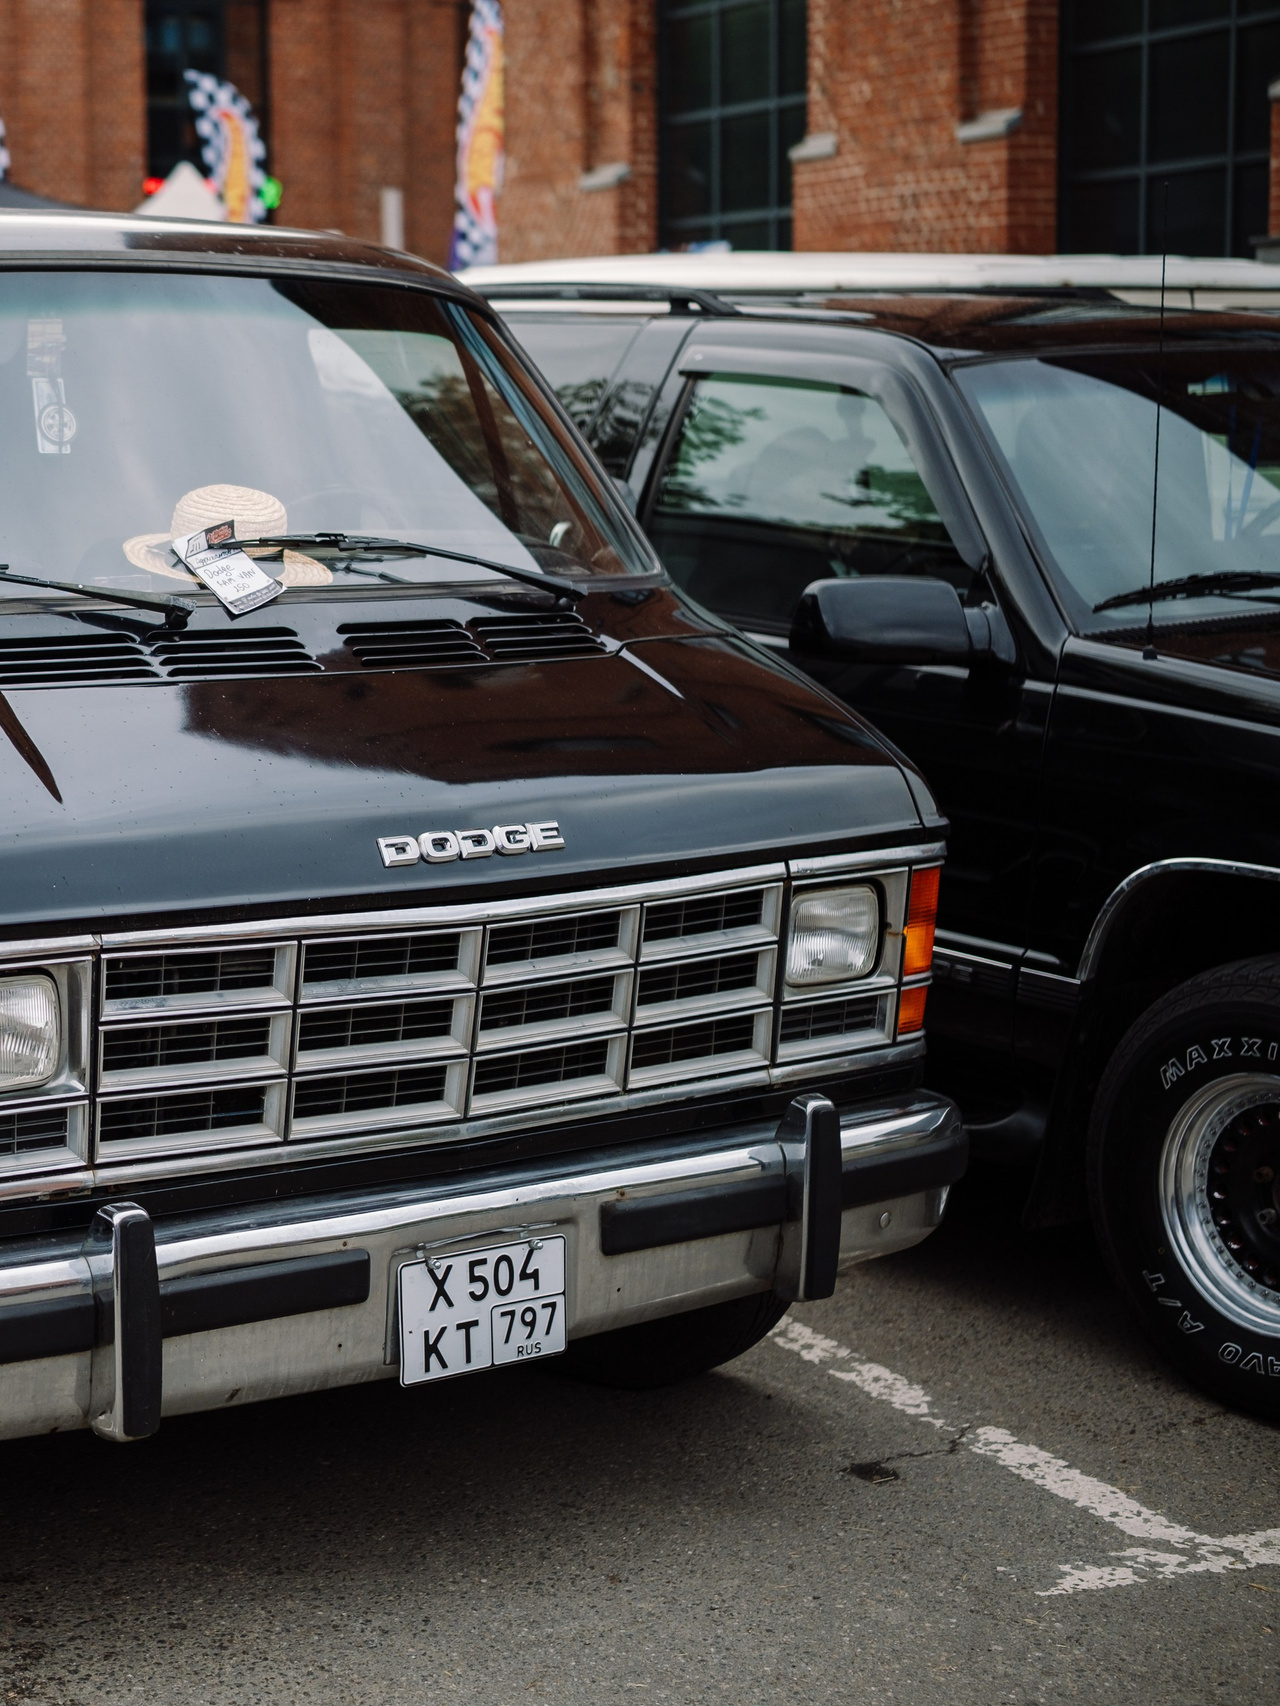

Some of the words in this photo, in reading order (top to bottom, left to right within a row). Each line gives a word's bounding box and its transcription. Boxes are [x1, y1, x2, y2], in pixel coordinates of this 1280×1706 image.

[204, 564, 235, 579] Dodge
[237, 568, 257, 579] VAN
[376, 820, 565, 868] DODGE
[427, 1264, 454, 1312] X
[468, 1249, 540, 1302] 504
[423, 1319, 480, 1373] KT
[500, 1301, 557, 1344] 797
[516, 1341, 542, 1358] RUS
